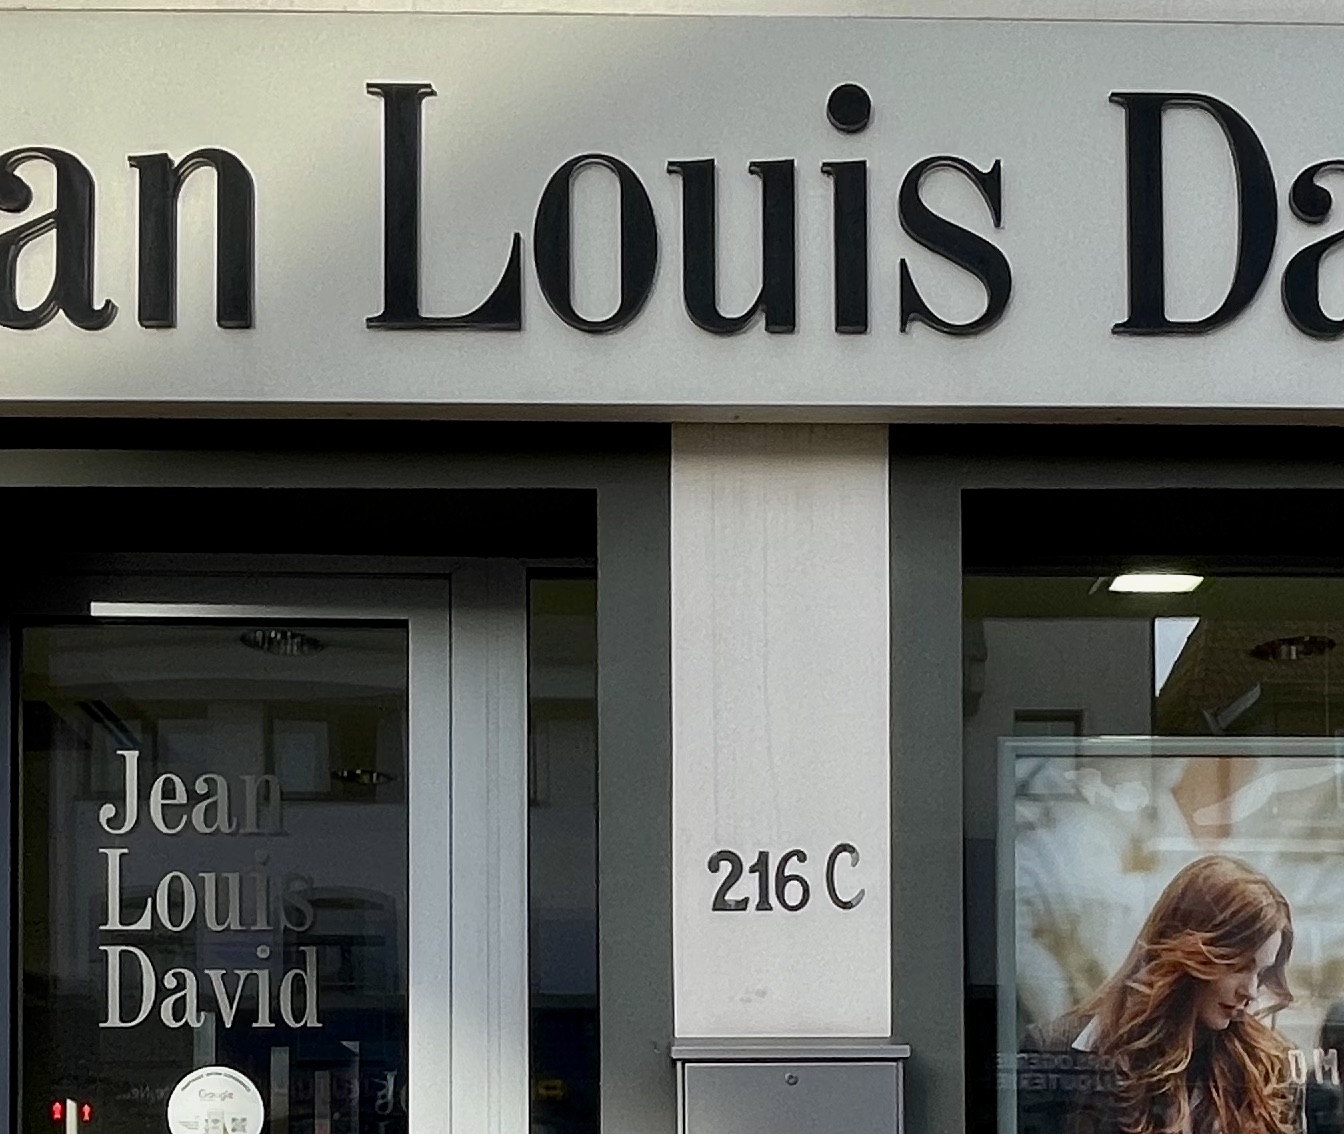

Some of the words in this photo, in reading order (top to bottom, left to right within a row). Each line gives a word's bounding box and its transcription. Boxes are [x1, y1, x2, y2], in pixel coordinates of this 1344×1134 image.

[365, 82, 1013, 335] Louis
[98, 749, 290, 836] Jean
[98, 847, 316, 932] Louis
[706, 849, 810, 913] 216
[825, 842, 865, 910] C
[98, 944, 323, 1028] David
